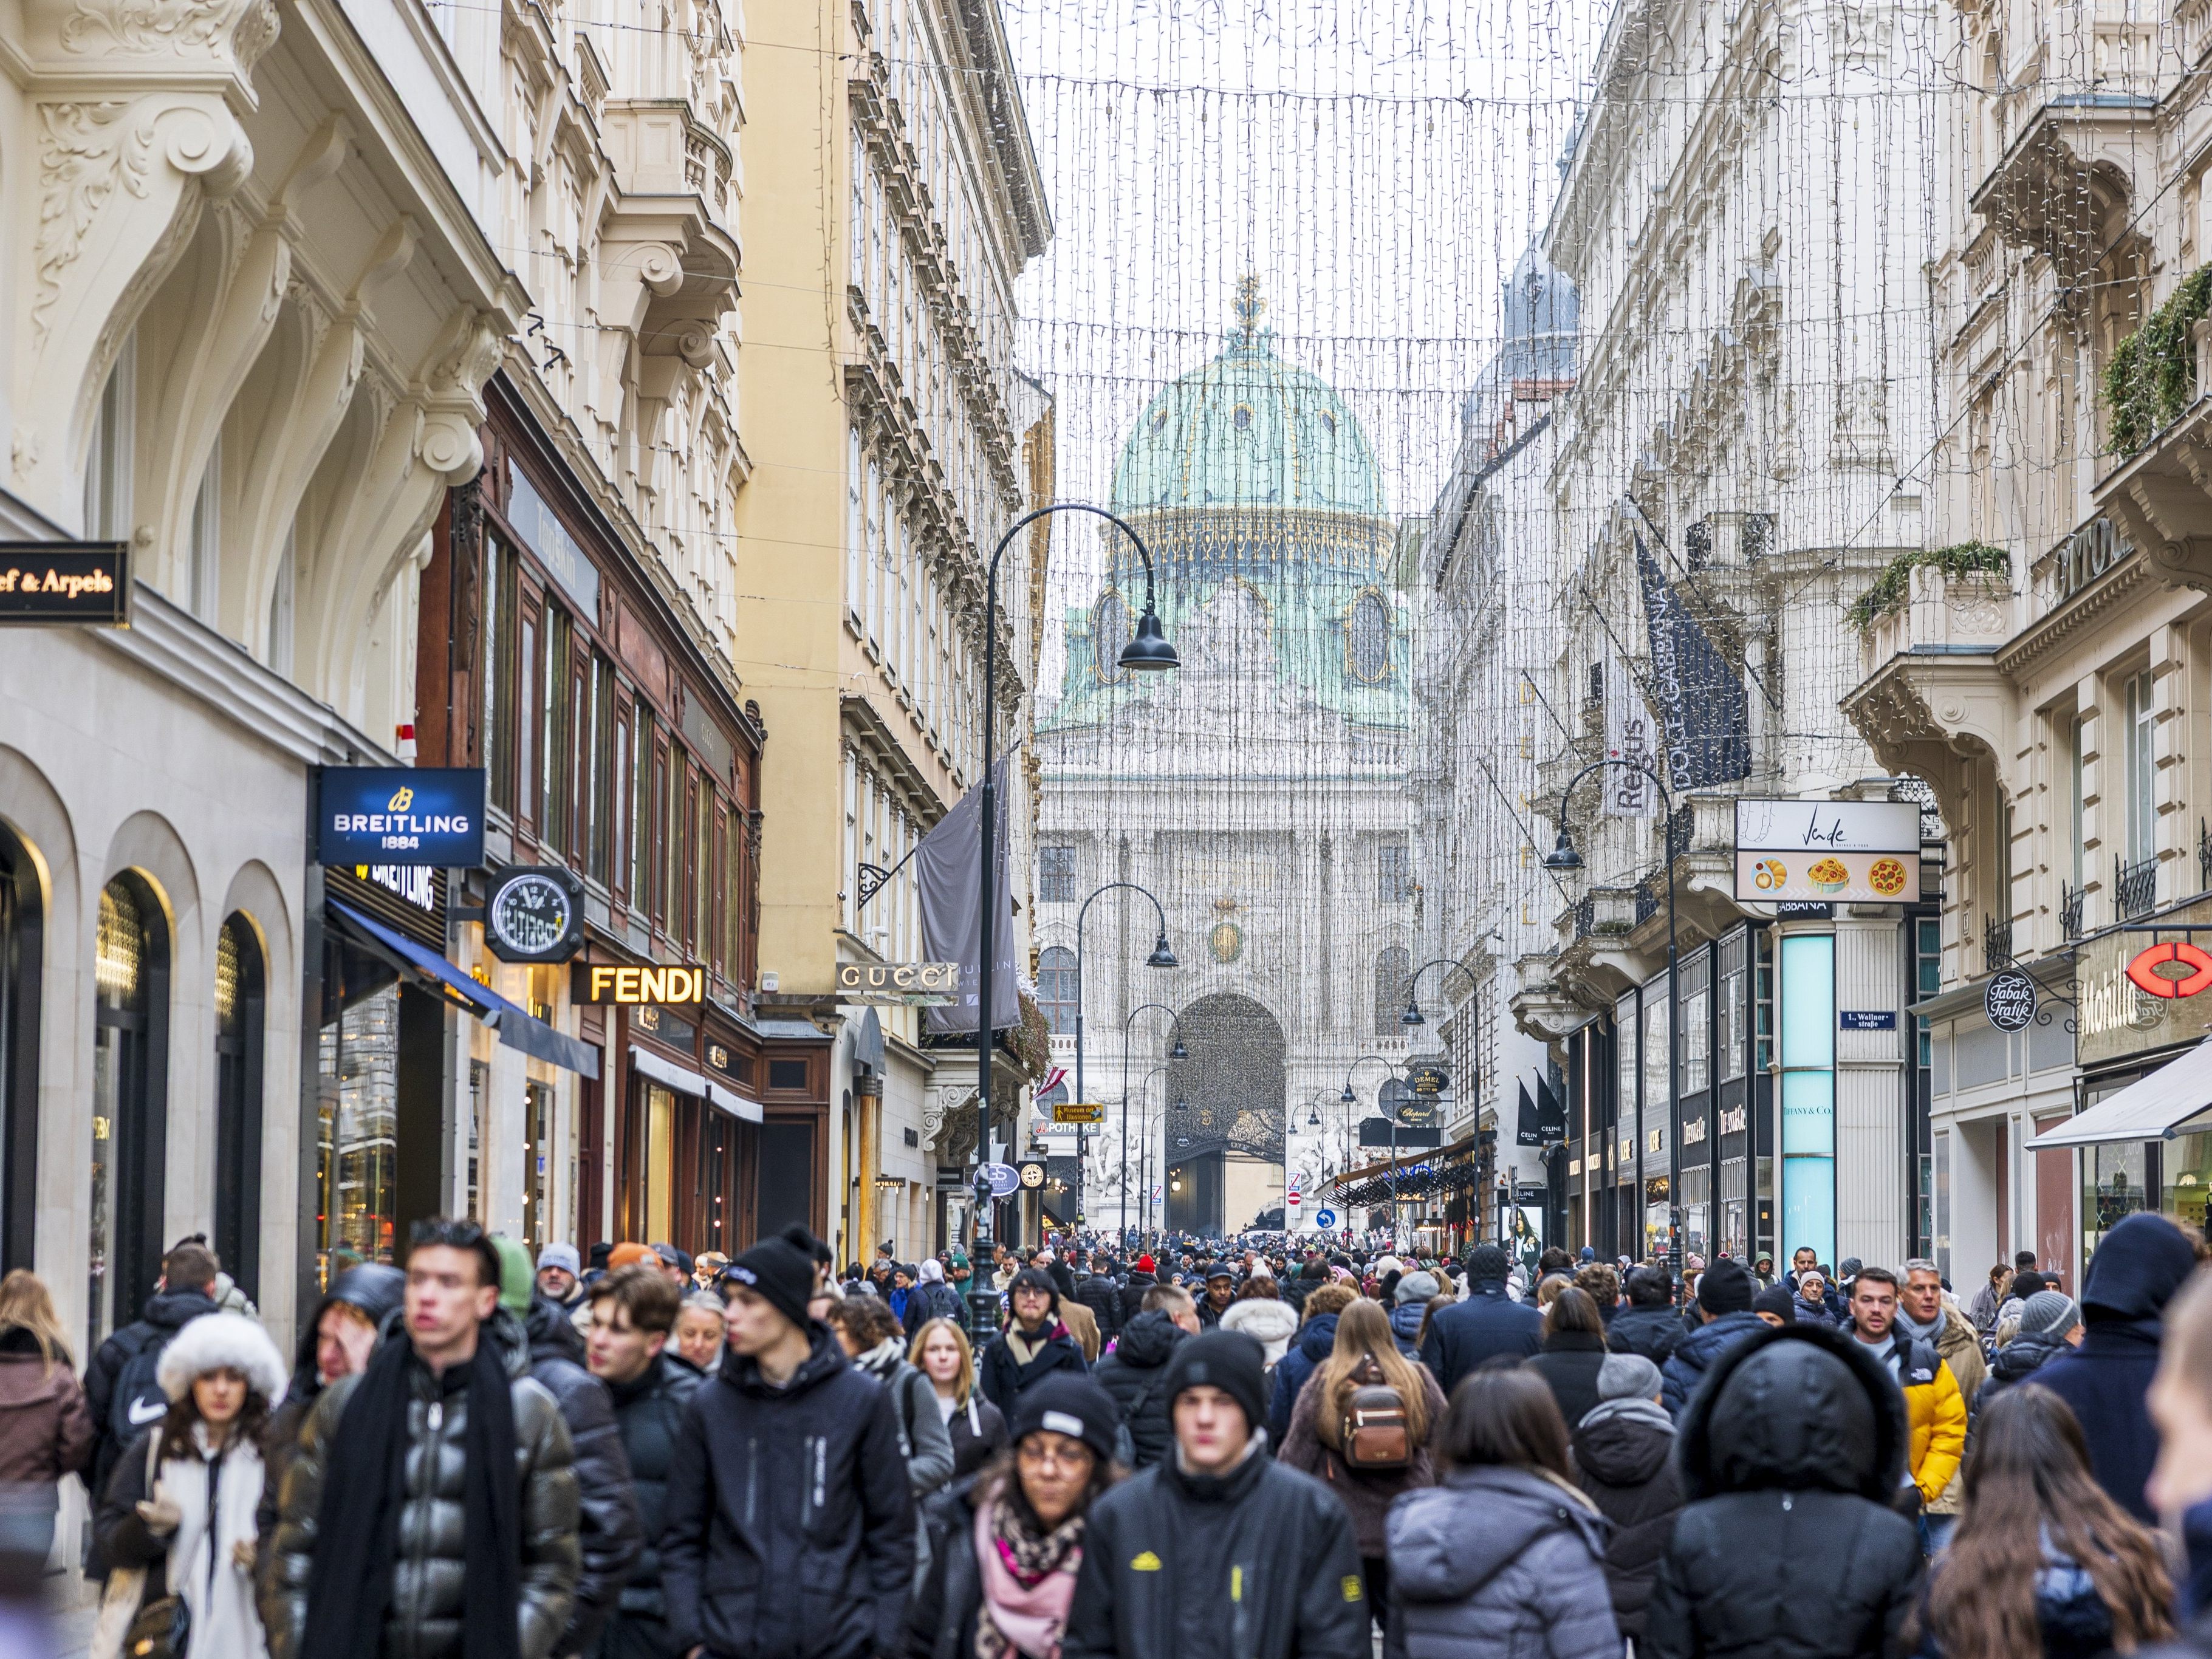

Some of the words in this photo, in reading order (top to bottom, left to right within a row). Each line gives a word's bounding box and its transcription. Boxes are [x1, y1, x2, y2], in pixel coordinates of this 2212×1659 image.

[21, 573, 41, 592] &
[41, 569, 113, 598] Arpels
[1617, 719, 1656, 809] Regus
[334, 814, 469, 833] BREITLING
[382, 835, 420, 850] 1884
[591, 966, 702, 1003] FENDI
[841, 966, 953, 987] GUCCI
[1990, 984, 2032, 1001] Tabak
[2081, 949, 2138, 1036] Mohilla
[1990, 1001, 2032, 1018] Trafik
[1400, 1107, 1433, 1118] Chopard
[1783, 1107, 1807, 1116] TIFFANY
[1036, 1121, 1097, 1134] APOTHKE
